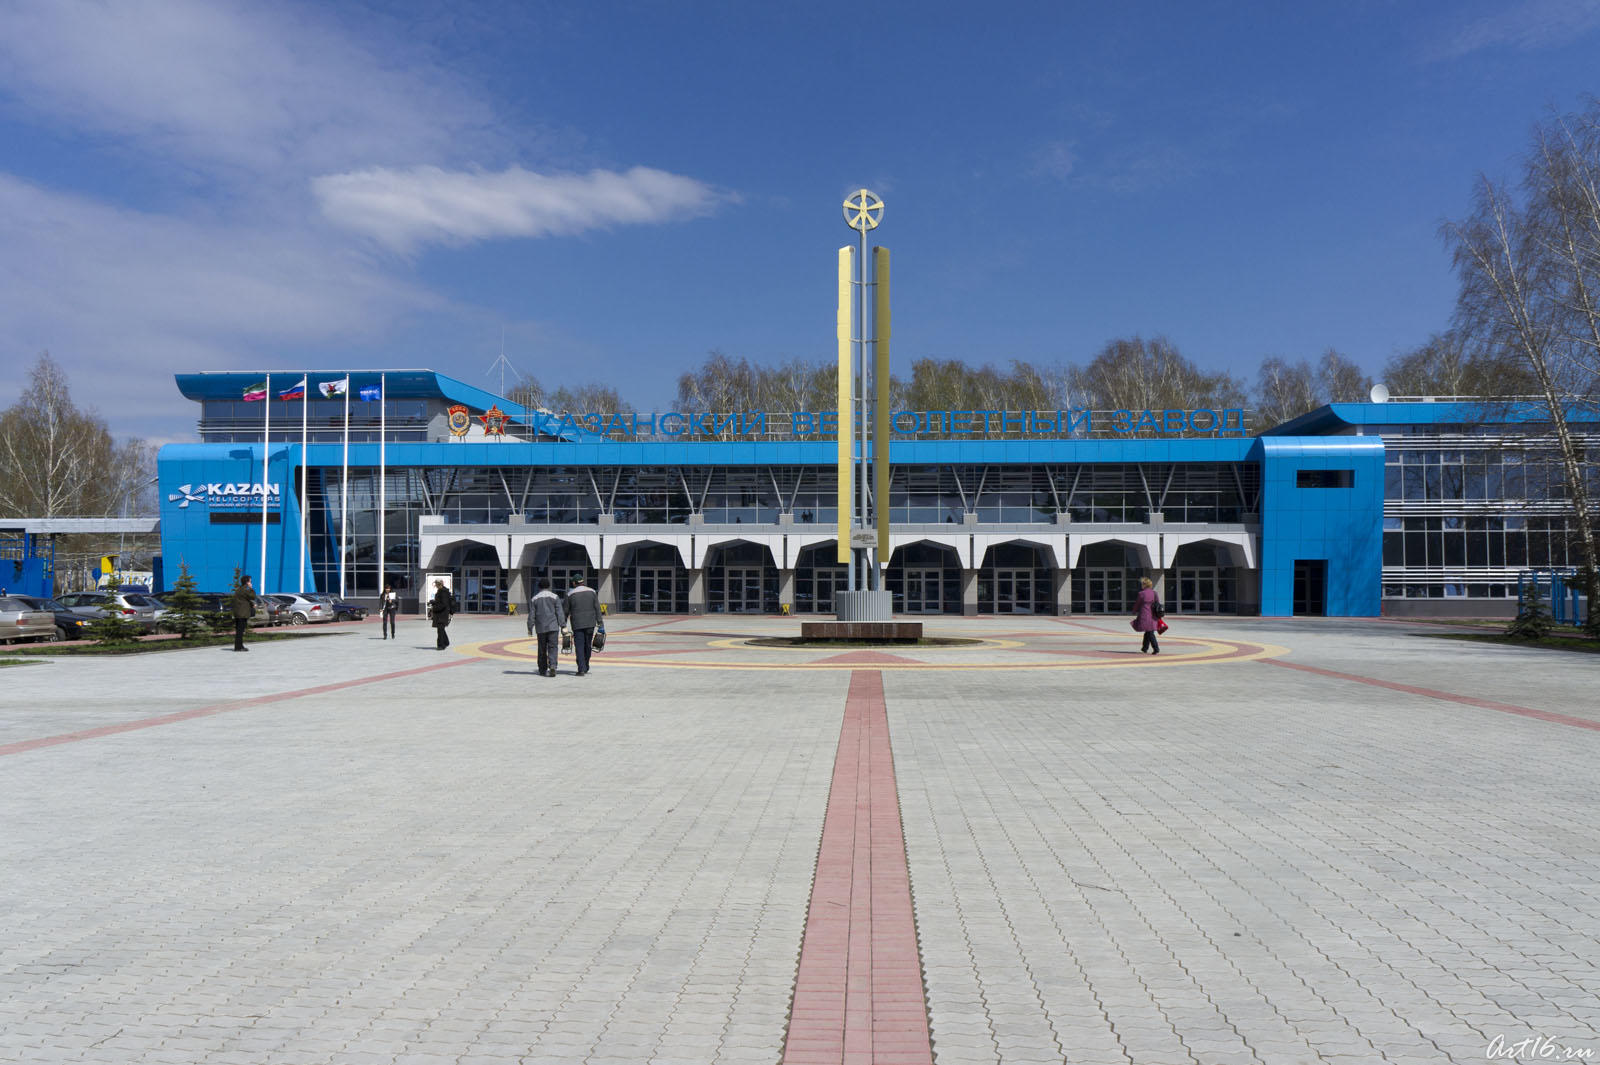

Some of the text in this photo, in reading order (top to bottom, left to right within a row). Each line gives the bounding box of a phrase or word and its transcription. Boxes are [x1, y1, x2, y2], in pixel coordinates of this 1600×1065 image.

[534, 405, 1247, 437] КАЗАНСКИЙ ВЕОЛЕТНЫЙ ЗАВОД
[207, 483, 280, 495] KAZAN
